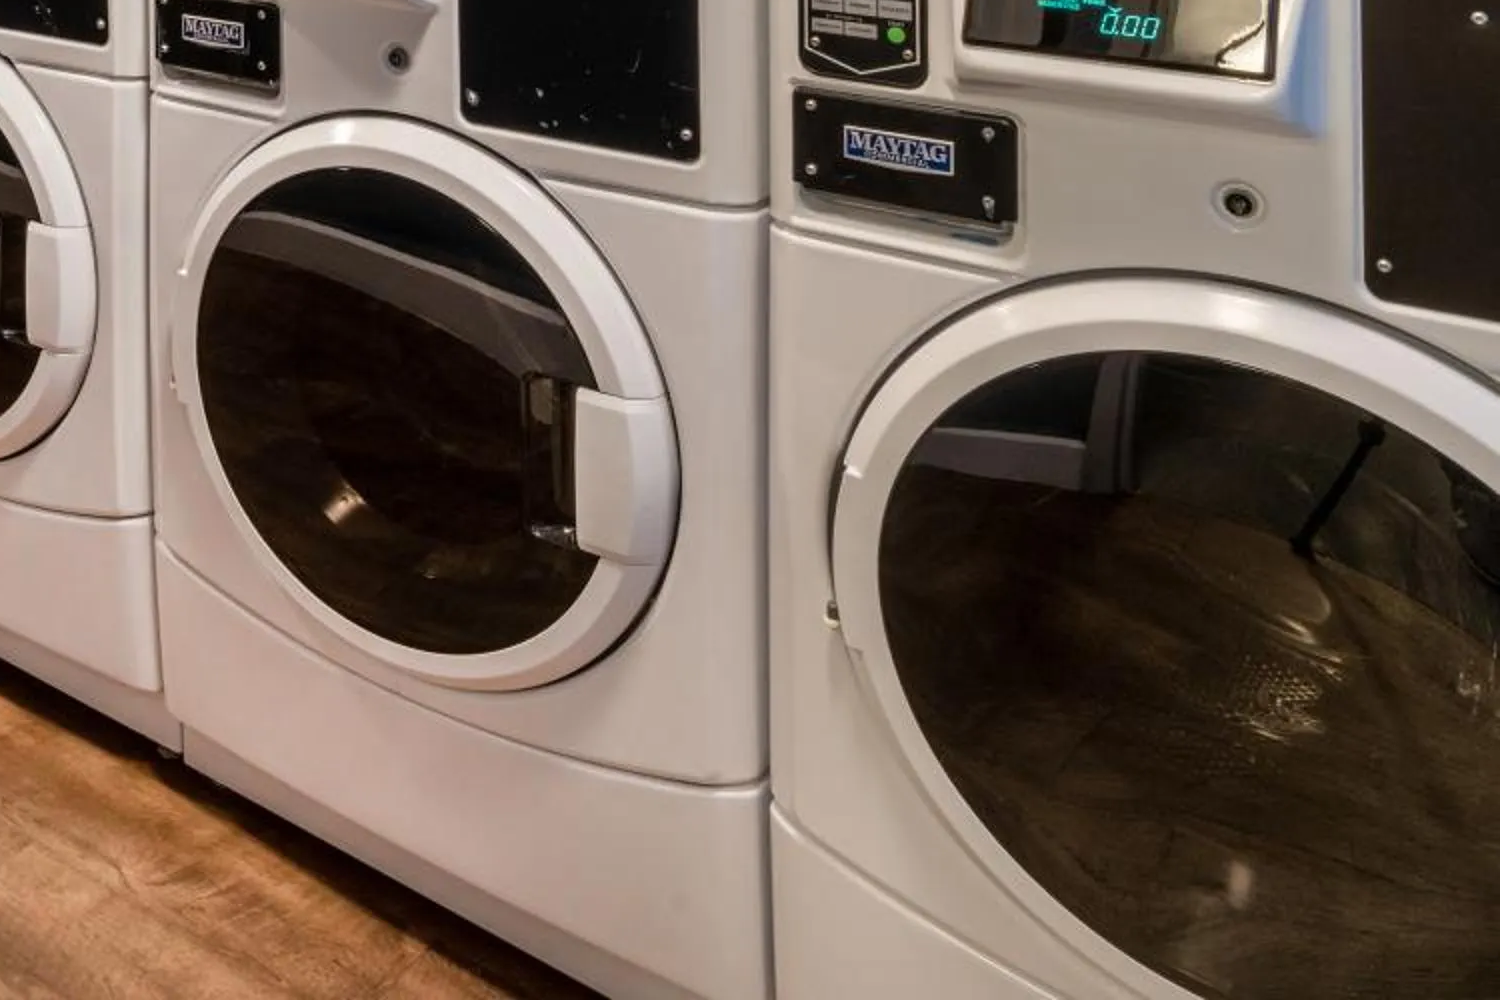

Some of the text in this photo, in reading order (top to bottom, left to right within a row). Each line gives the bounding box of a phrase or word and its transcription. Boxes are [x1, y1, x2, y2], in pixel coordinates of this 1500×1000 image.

[185, 18, 240, 40] MAYTAG
[1099, 13, 1161, 40] 0.00
[849, 130, 949, 163] MAYTAG
